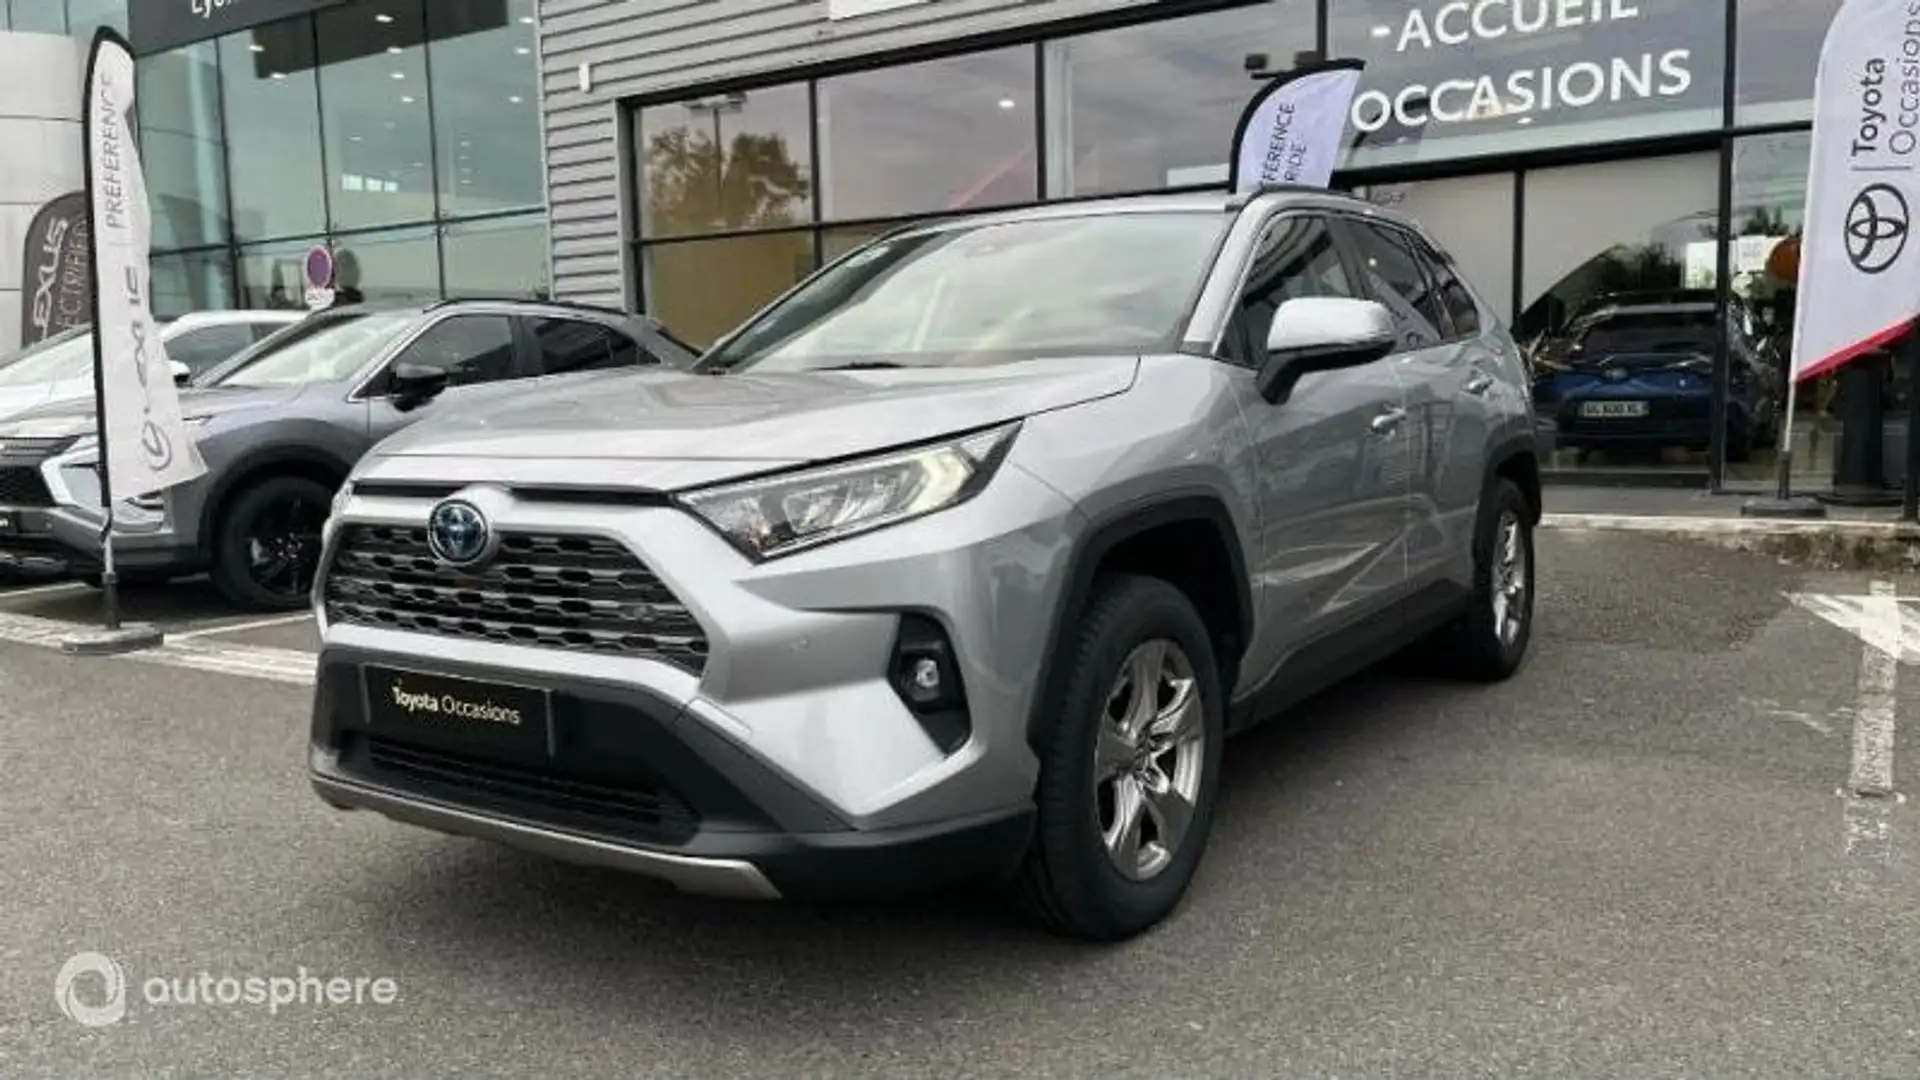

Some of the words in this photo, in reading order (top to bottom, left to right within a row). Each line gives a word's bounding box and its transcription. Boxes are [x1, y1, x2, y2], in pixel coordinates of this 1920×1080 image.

[192, 0, 237, 19] Lyo
[1351, 49, 1692, 132] OCCASIONS
[1850, 57, 1887, 157] Toyota
[1888, 0, 1920, 155] Occasions
[33, 217, 68, 339] EXUS
[391, 685, 438, 712] Toyota
[441, 695, 521, 725] Occasions
